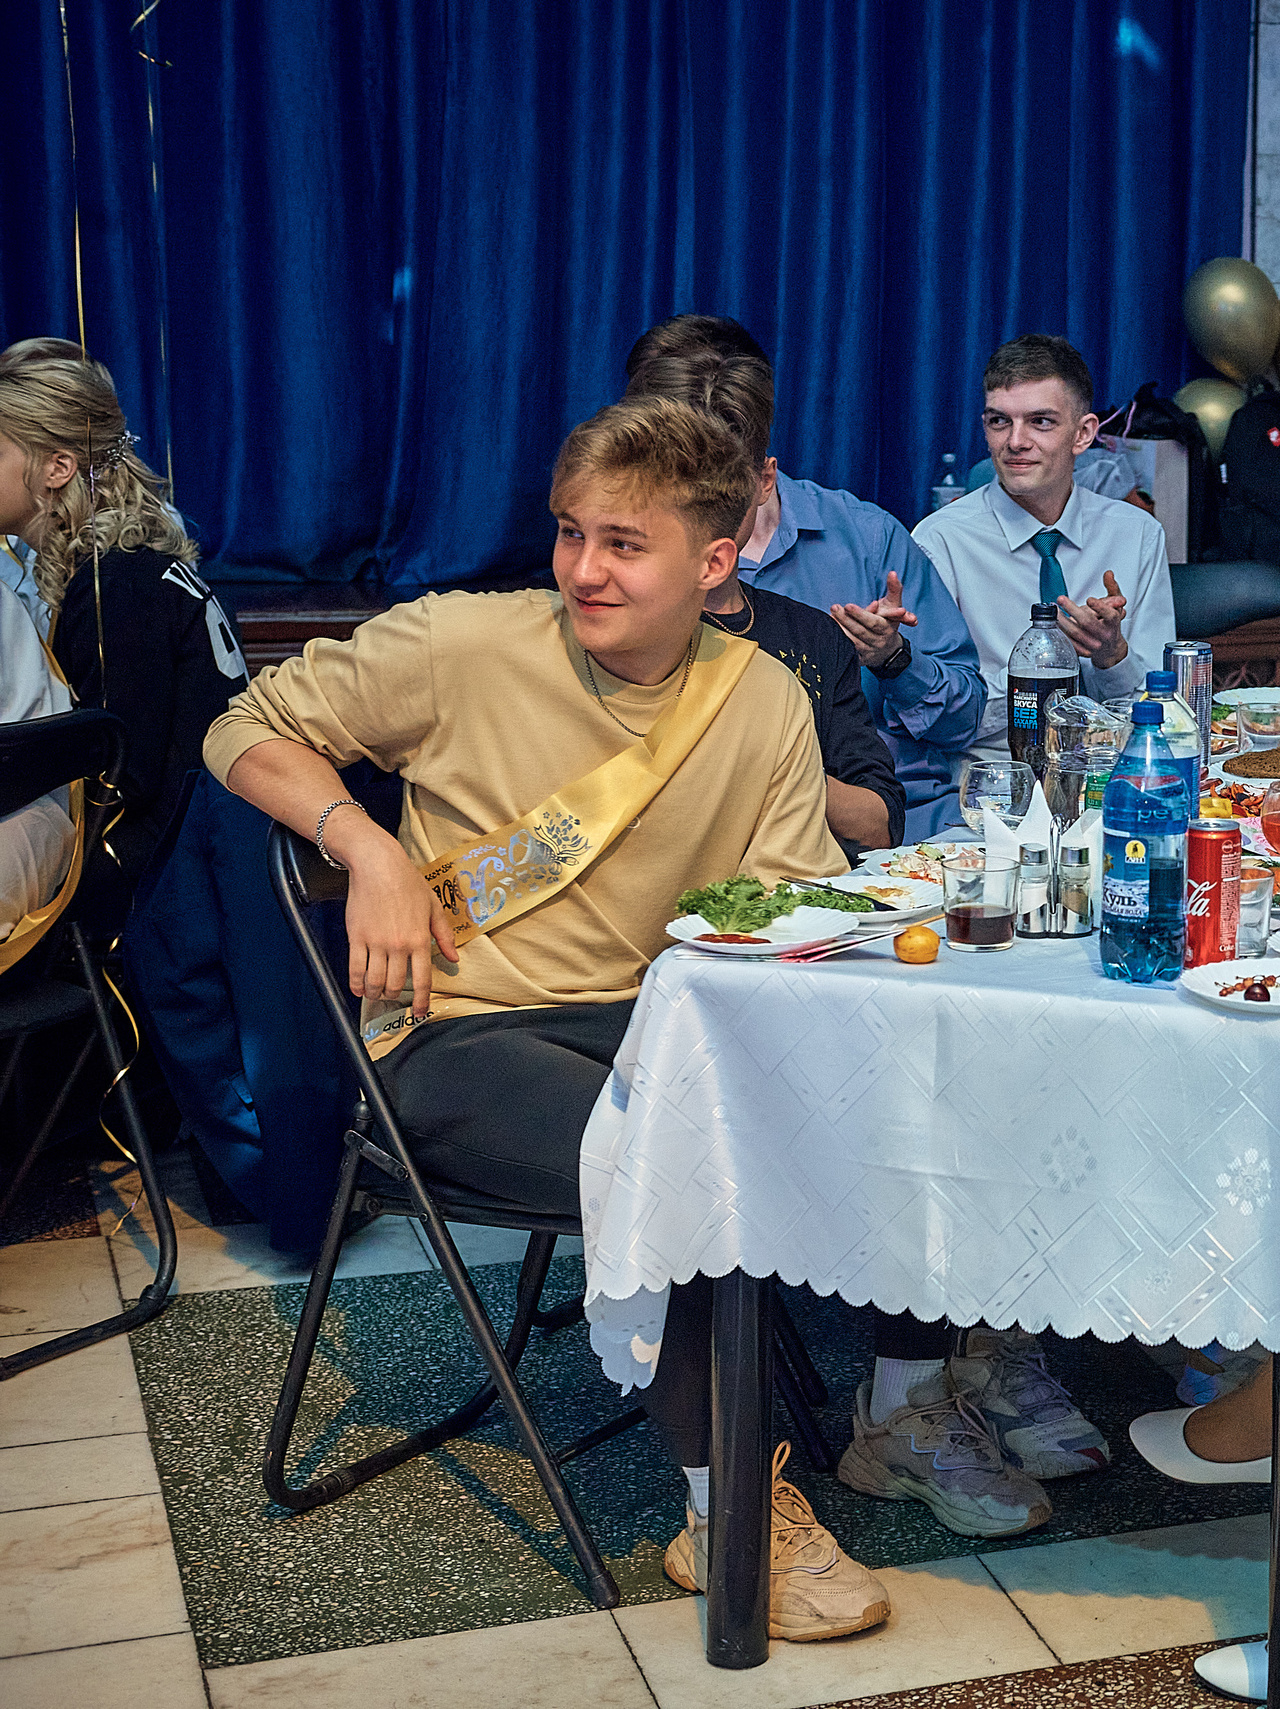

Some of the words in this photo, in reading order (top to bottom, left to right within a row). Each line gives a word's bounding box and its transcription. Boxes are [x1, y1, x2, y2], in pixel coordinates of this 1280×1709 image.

[1013, 700, 1038, 709] ВКУСА
[1013, 707, 1038, 719] БЕЗ
[1013, 718, 1038, 728] САХАРА
